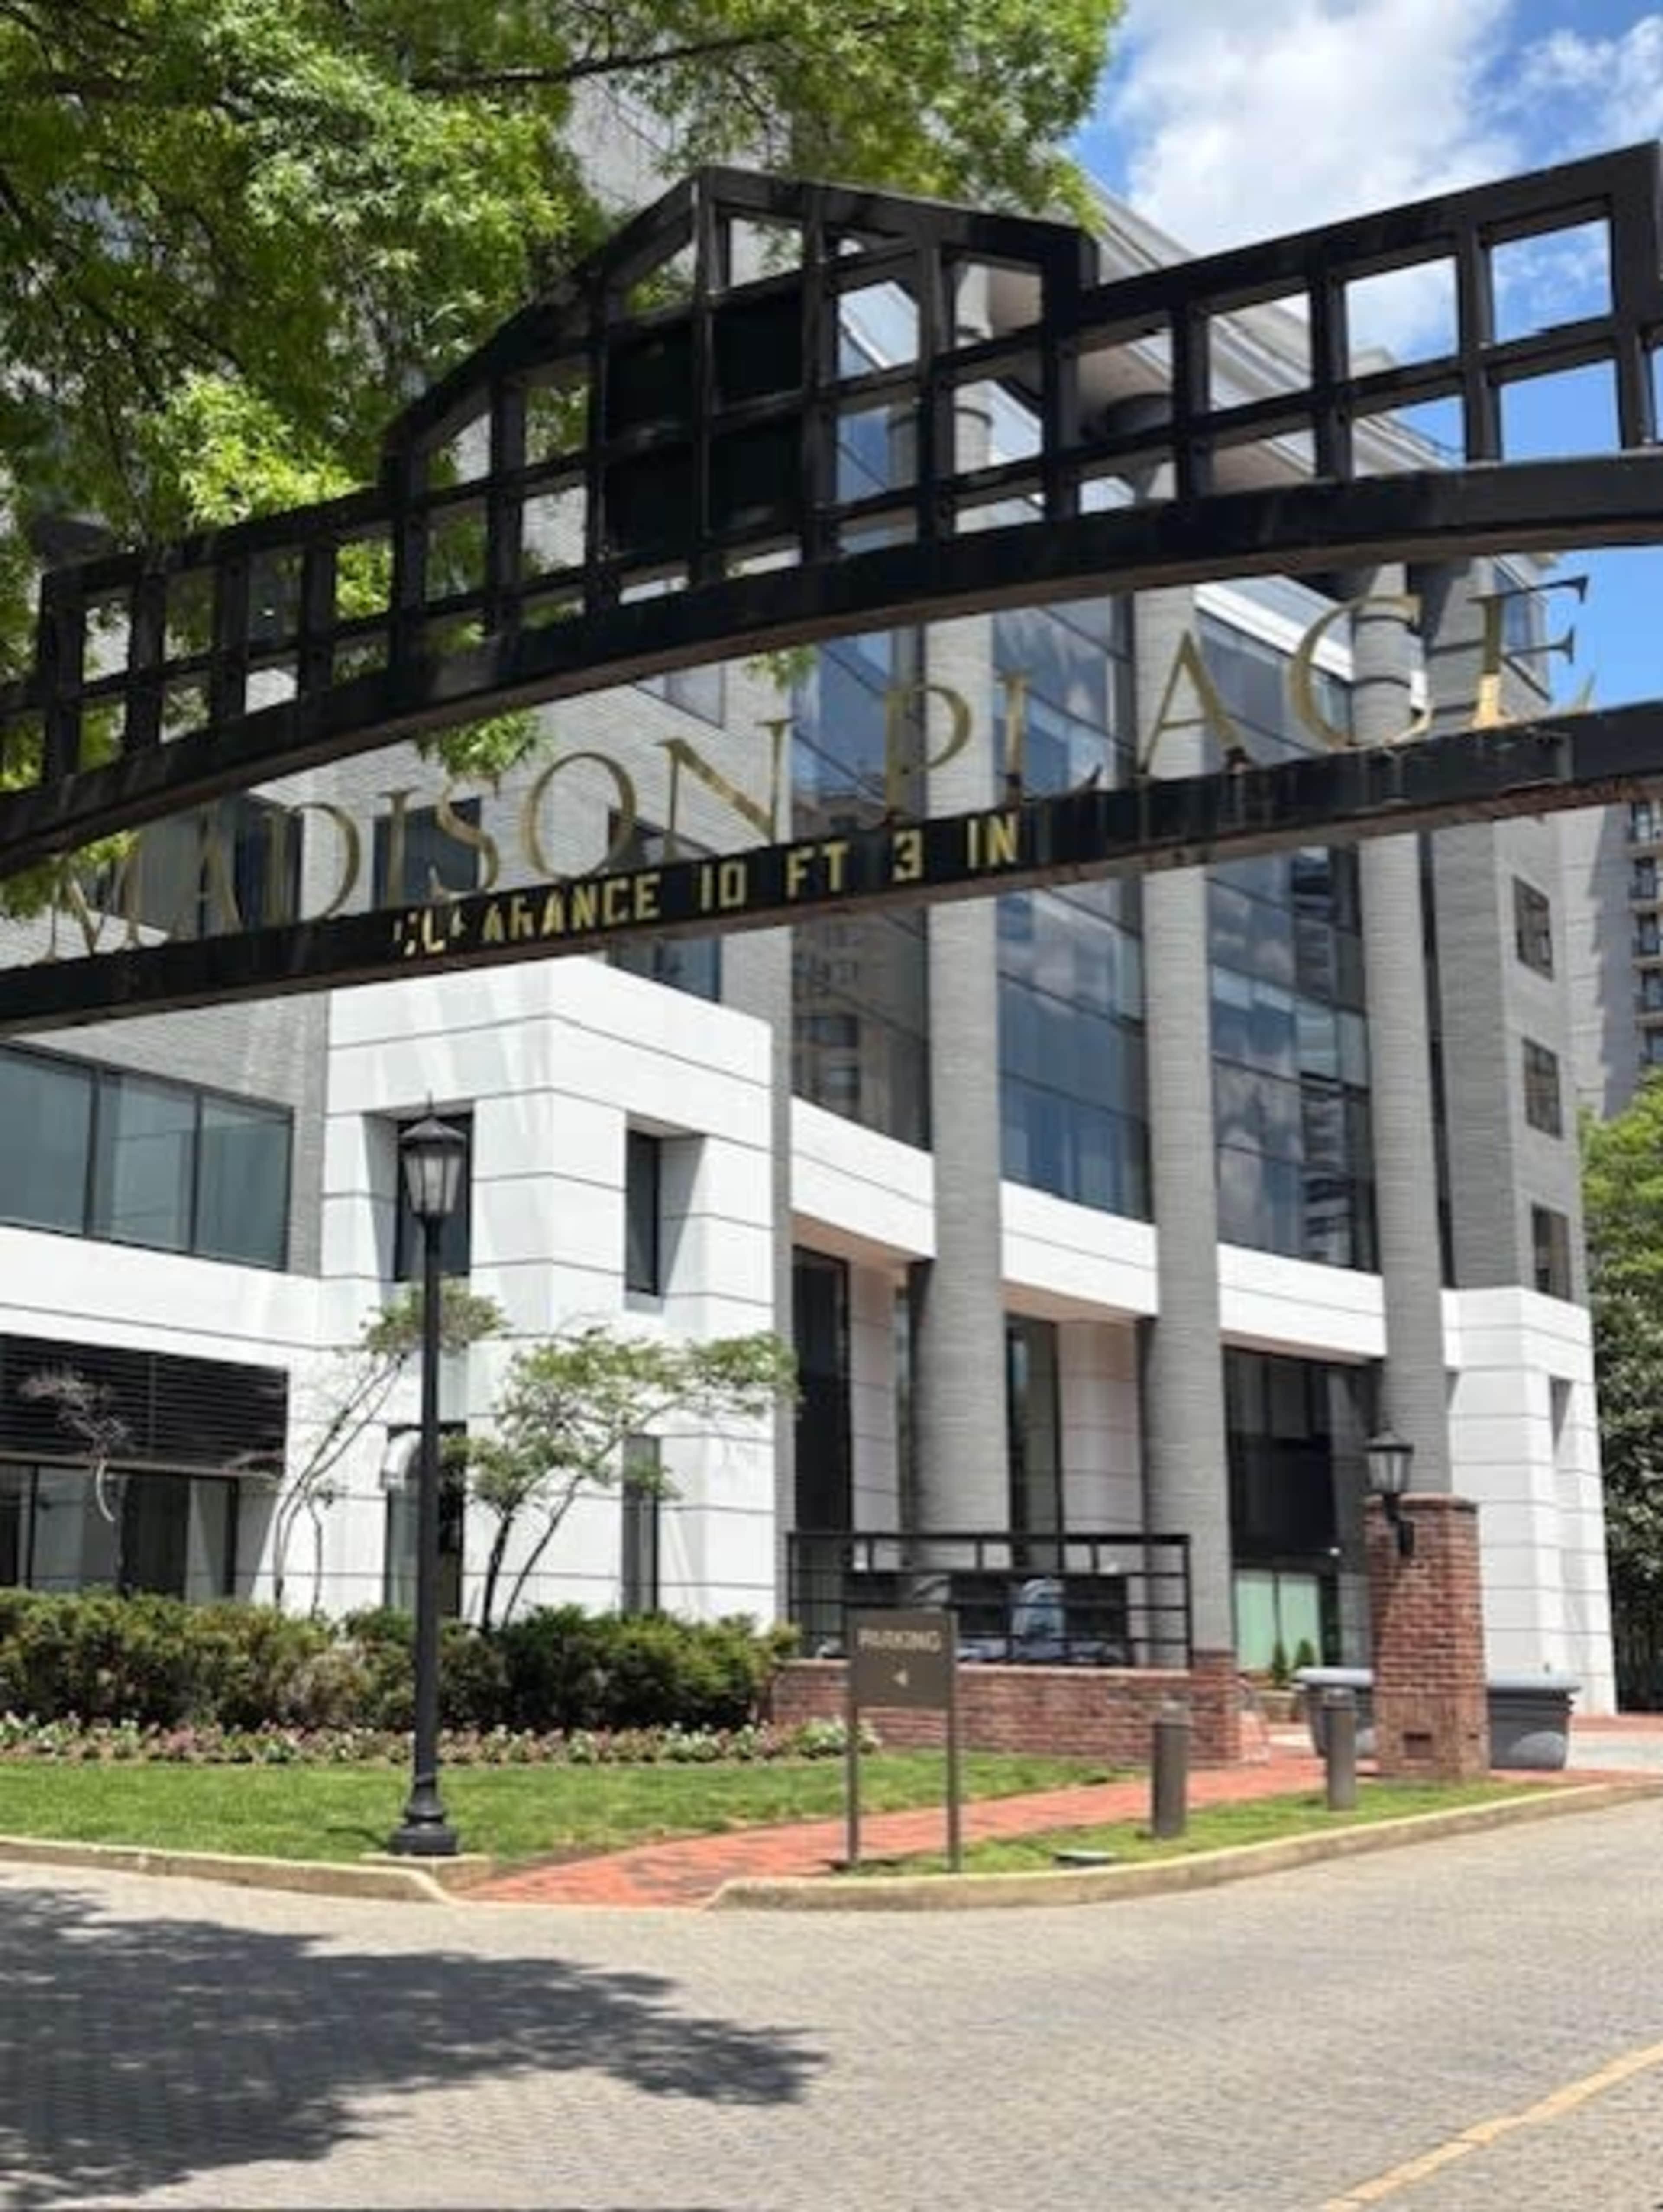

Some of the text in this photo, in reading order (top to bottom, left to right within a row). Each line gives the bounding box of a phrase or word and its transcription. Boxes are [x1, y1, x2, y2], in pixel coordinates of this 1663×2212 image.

[36, 574, 1595, 962] MADISON PLACE
[700, 860, 747, 912] 10
[786, 840, 849, 899] FT
[893, 829, 923, 884] 3
[967, 814, 1018, 870] IN
[857, 1628, 942, 1653] PARKING
